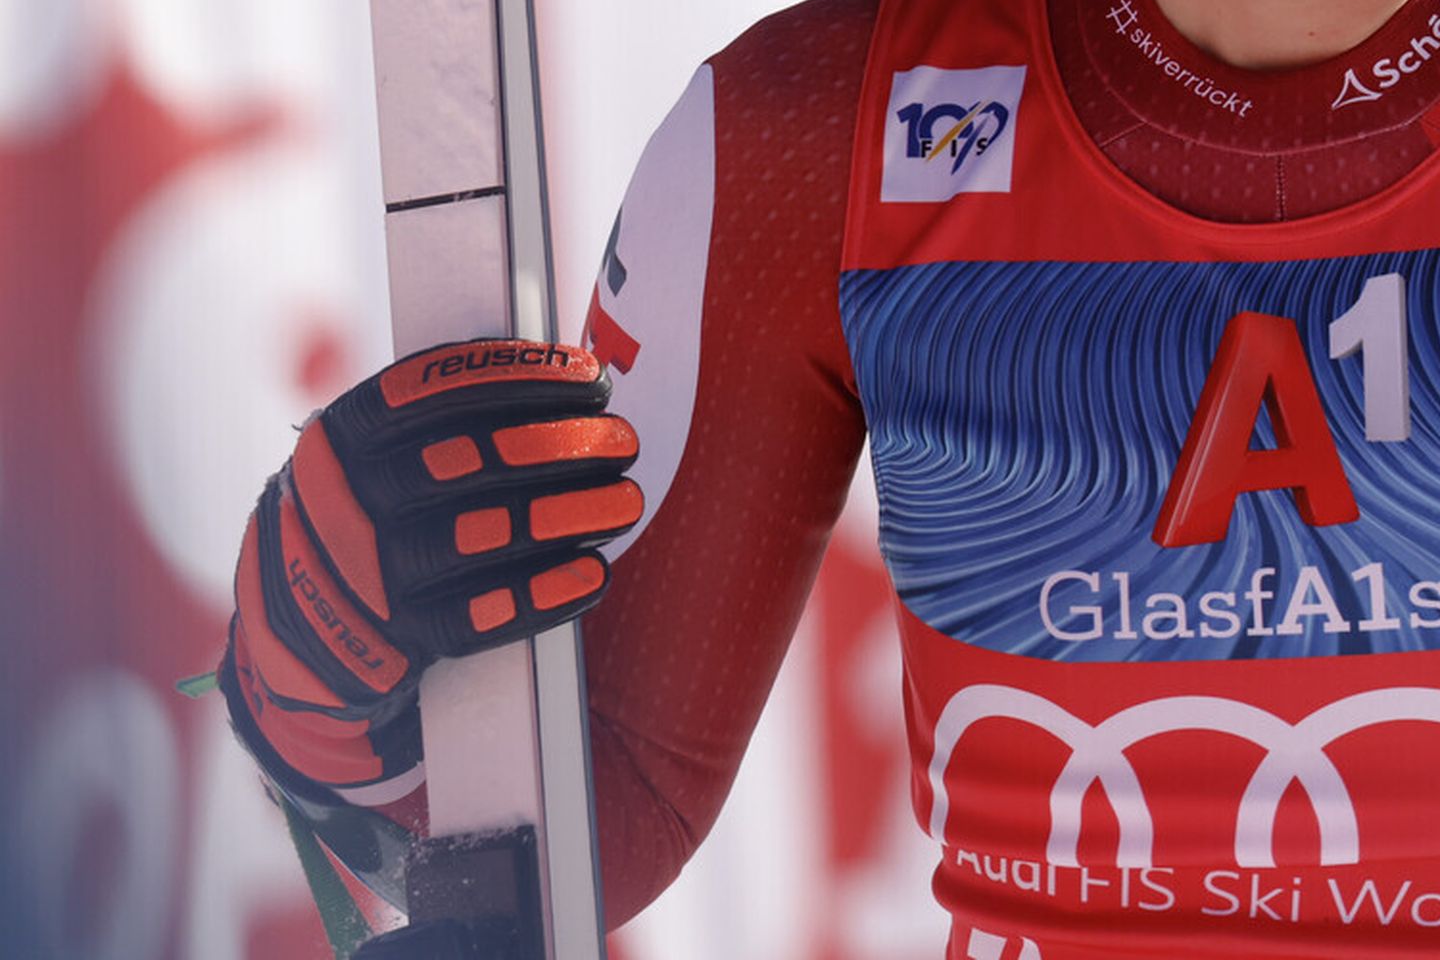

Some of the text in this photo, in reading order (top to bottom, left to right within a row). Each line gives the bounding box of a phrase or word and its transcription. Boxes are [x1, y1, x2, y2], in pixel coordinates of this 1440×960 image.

[920, 137, 988, 158] FIS
[423, 341, 570, 385] reusch
[1151, 272, 1412, 549] A1
[289, 557, 386, 670] reusch
[1080, 866, 1176, 911] FIS
[1200, 870, 1301, 923] Ski
